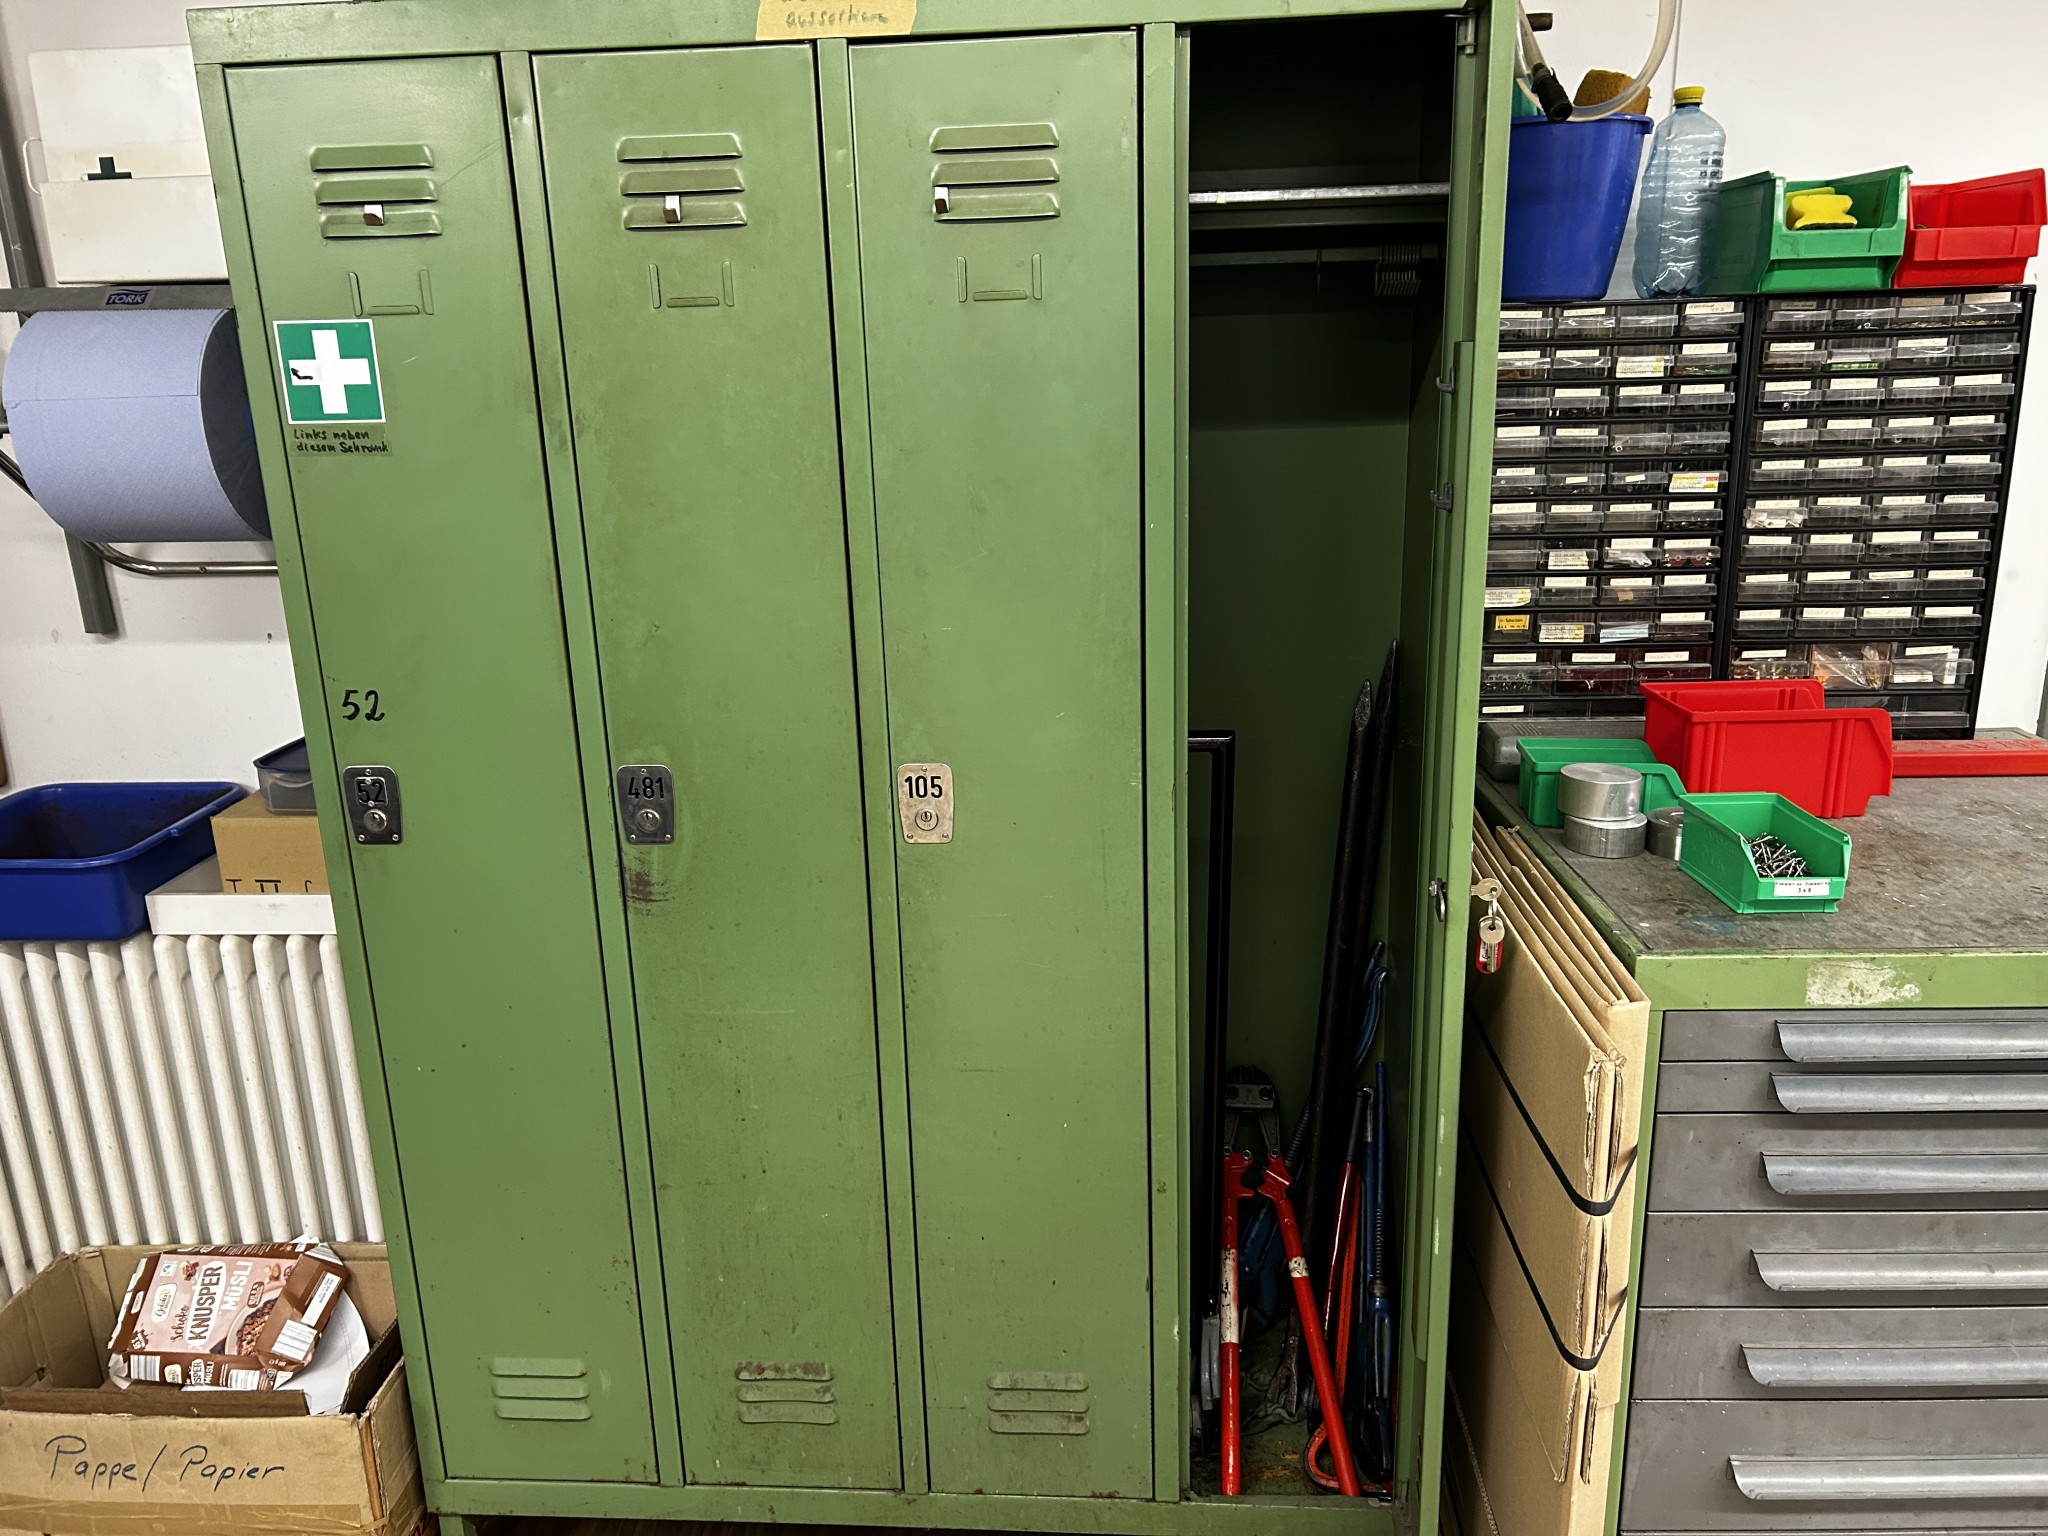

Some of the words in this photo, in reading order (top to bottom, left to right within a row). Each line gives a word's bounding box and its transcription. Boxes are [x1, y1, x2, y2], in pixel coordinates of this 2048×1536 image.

[108, 294, 146, 304] TORK
[293, 428, 327, 441] Links
[332, 429, 370, 440] neben
[296, 442, 336, 453] diesem
[339, 440, 389, 454] Schrank
[342, 689, 385, 721] 52
[356, 780, 386, 804] 52
[627, 776, 665, 800] 481
[904, 775, 943, 799] 105
[220, 1260, 253, 1311] MÜSLI
[187, 1265, 223, 1341] KNUSPER
[170, 1304, 190, 1343] Schoko
[193, 1361, 203, 1384] SPER
[179, 1444, 285, 1492] Papier
